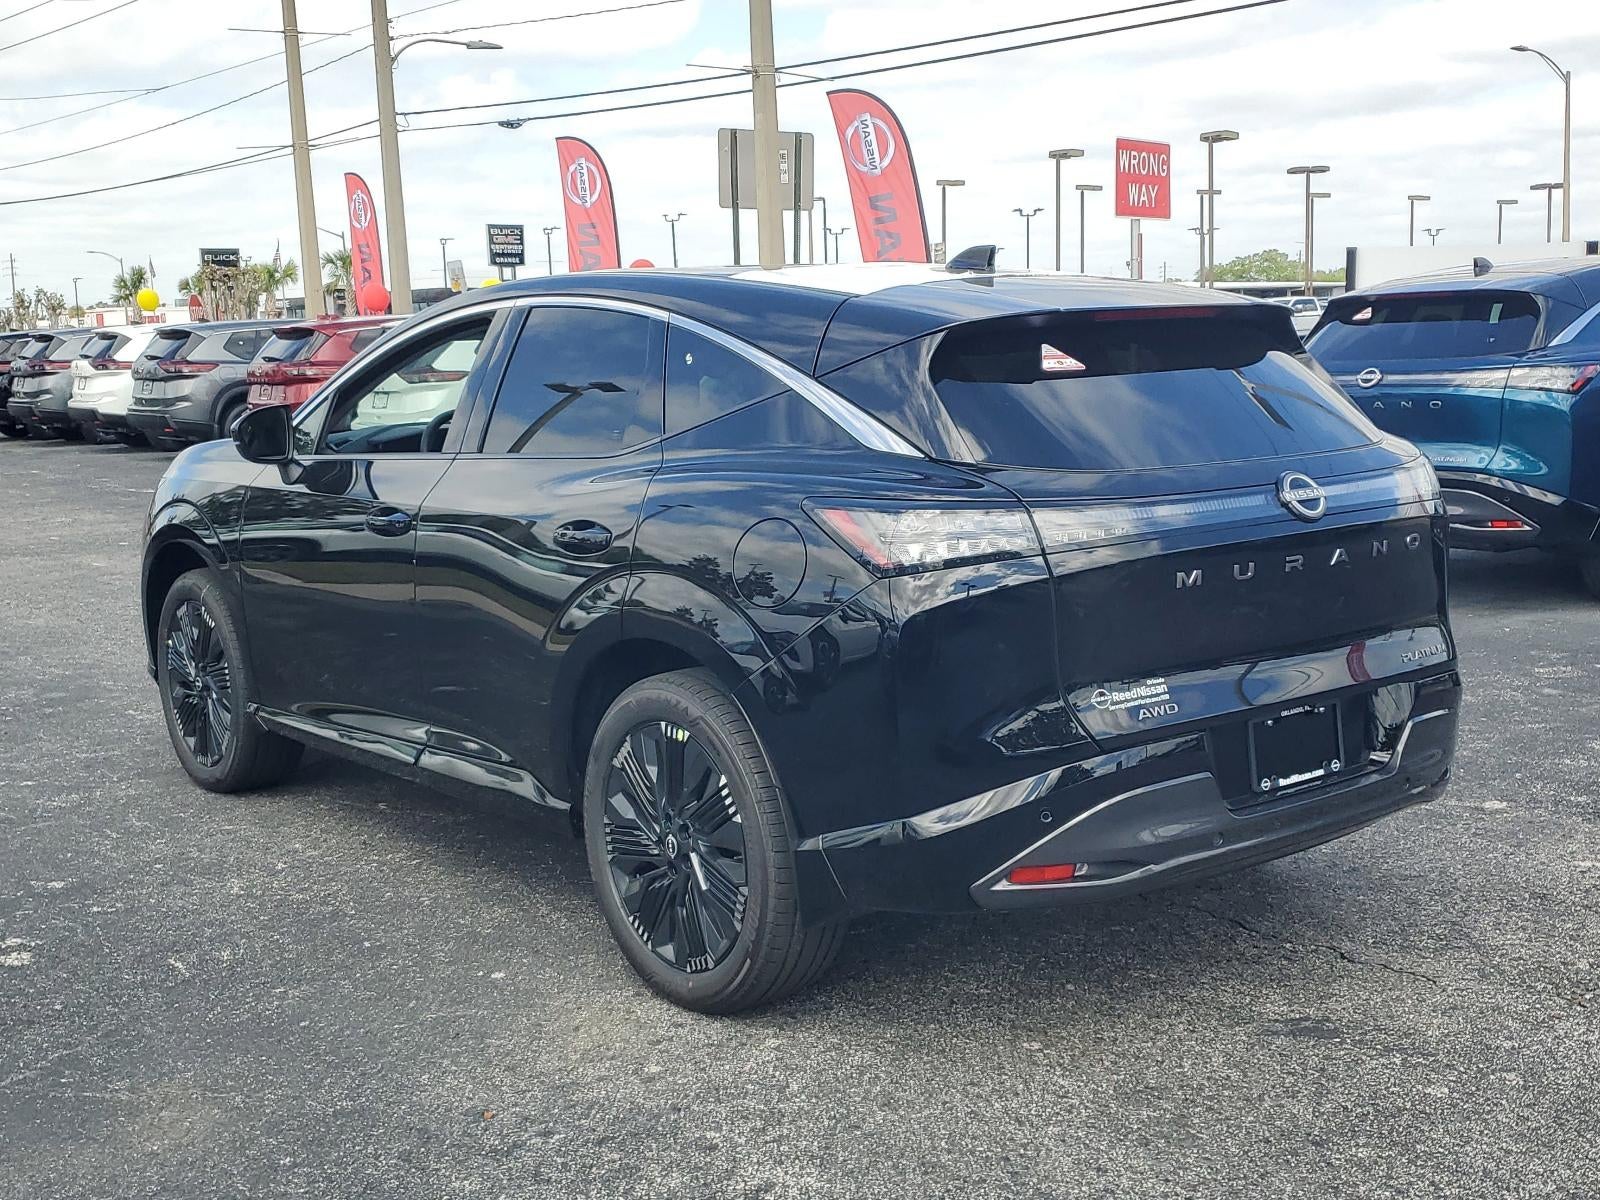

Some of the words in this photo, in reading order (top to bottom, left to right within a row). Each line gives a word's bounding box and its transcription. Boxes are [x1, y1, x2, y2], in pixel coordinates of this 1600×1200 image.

[1119, 149, 1168, 177] WRONG
[1128, 182, 1160, 208] WAY
[1373, 400, 1442, 409] ANO
[1283, 488, 1325, 501] NISSAN
[1175, 533, 1421, 589] MURANO
[1400, 643, 1448, 664] PLATINUM
[1138, 703, 1179, 720] AWD
